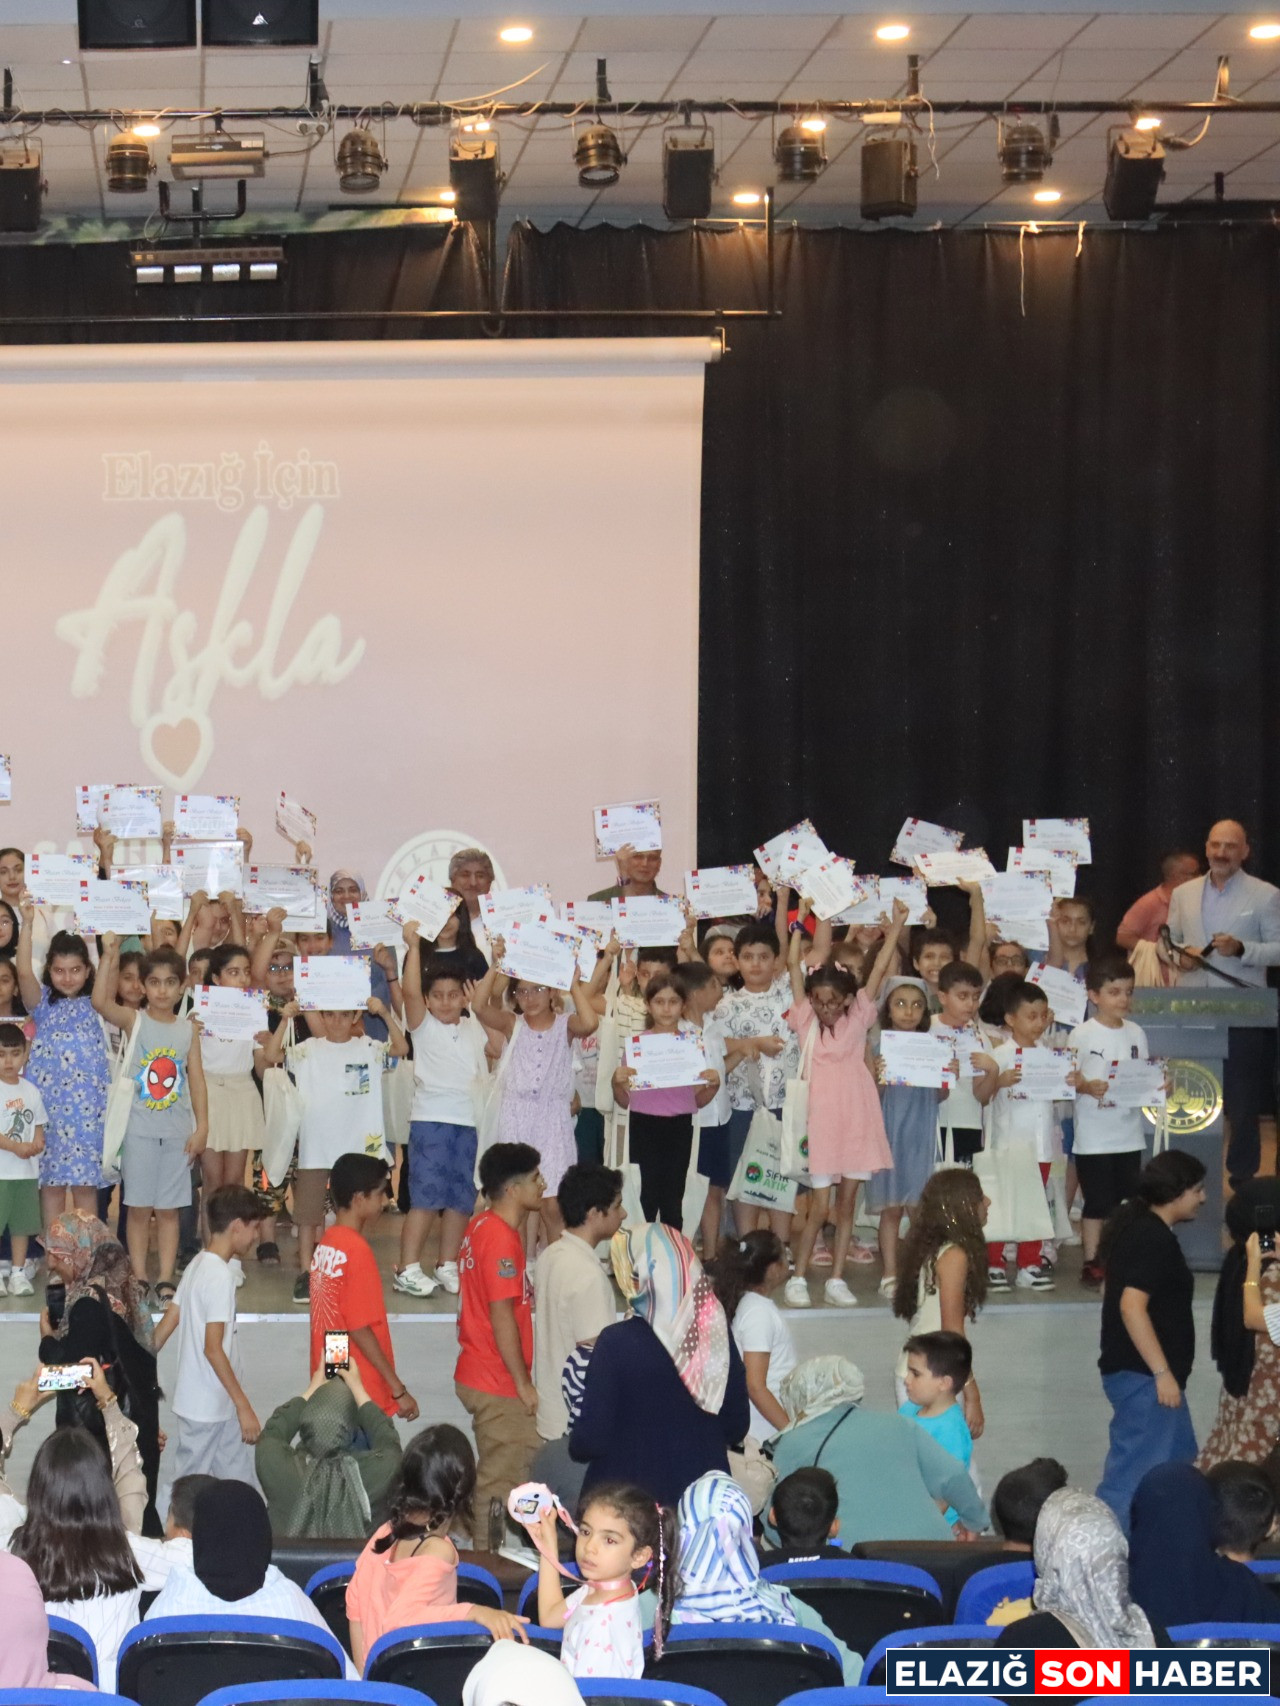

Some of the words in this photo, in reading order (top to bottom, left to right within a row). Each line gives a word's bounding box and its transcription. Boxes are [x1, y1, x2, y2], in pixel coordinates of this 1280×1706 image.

[101, 449, 244, 513] Elazığ
[253, 440, 340, 509] İçin
[141, 1047, 177, 1067] SUPER
[762, 1180, 789, 1192] ATIK
